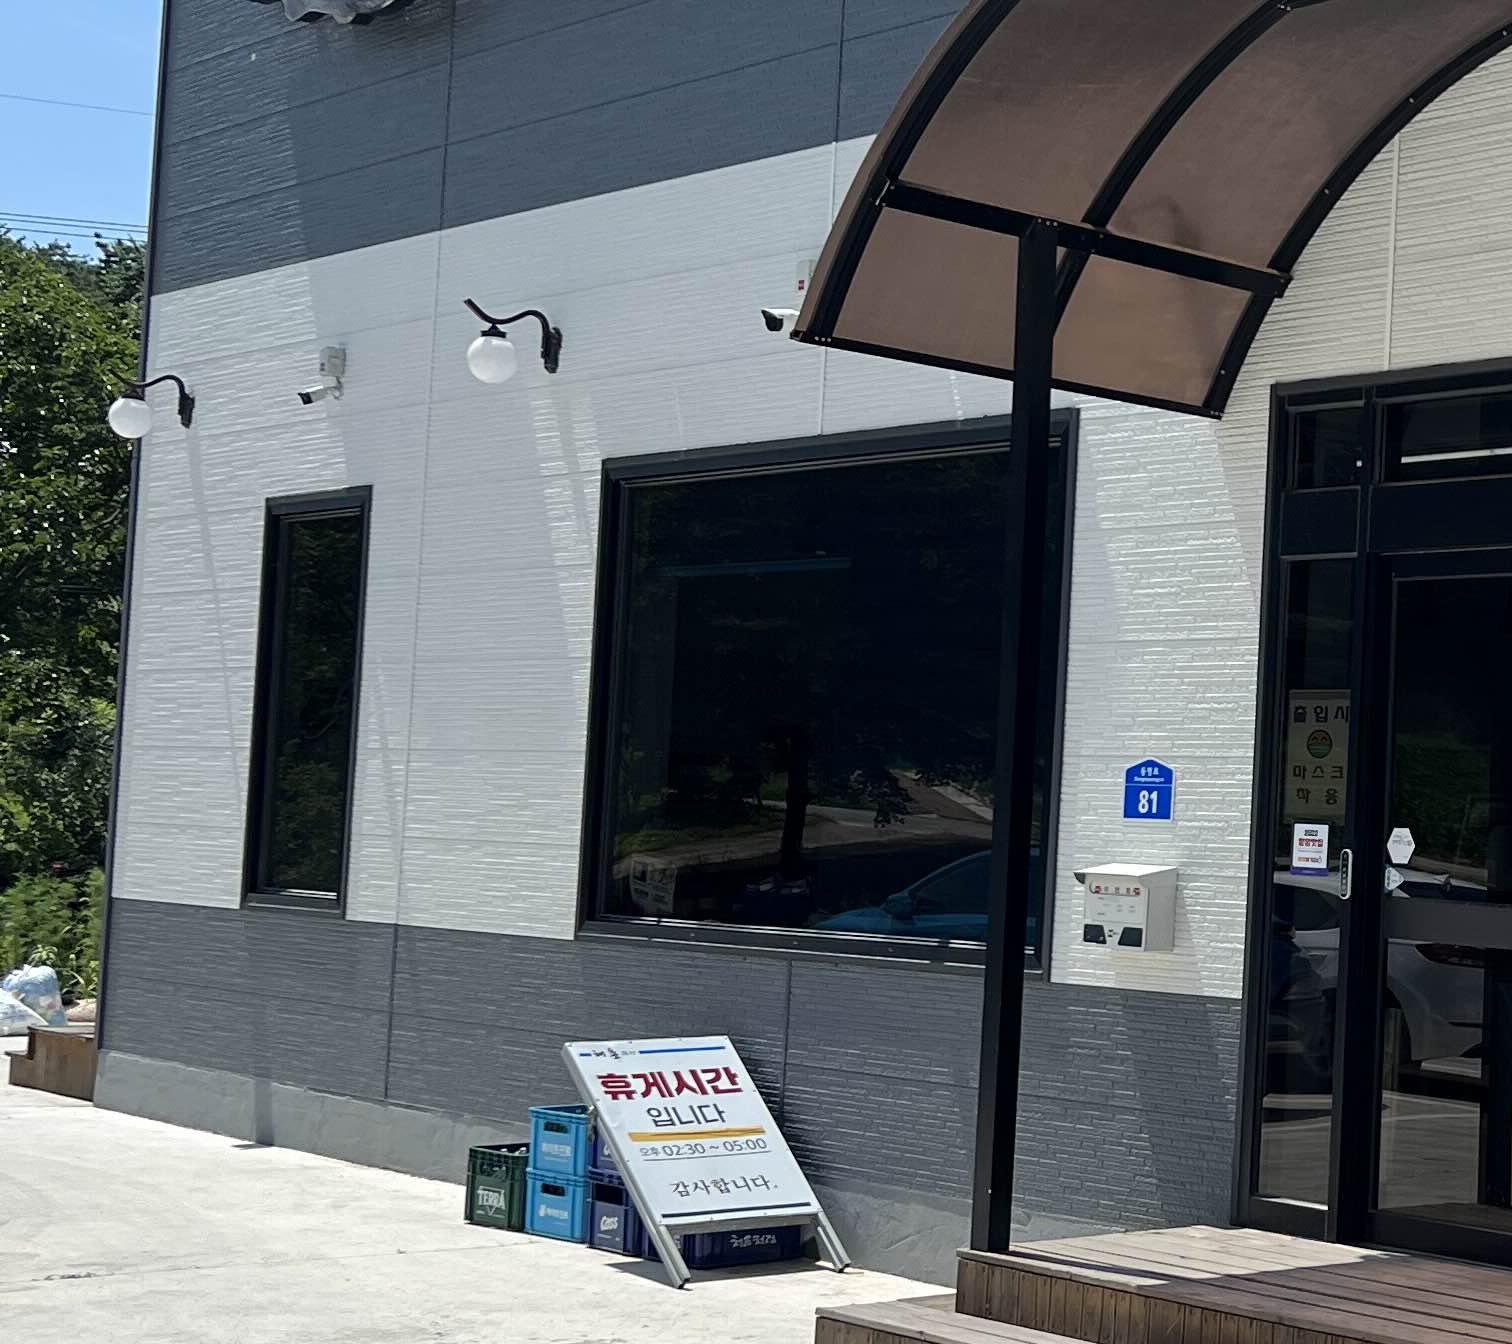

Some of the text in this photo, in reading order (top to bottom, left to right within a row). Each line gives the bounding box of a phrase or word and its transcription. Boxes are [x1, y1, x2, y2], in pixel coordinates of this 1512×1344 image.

[1293, 764, 1344, 780] 마스크
[1138, 790, 1158, 814] 81
[597, 1066, 743, 1101] 휴게시간
[646, 1103, 727, 1128] 입니다
[662, 1143, 705, 1157] 02:30
[724, 1137, 767, 1153] 05:00
[476, 1189, 506, 1209] TERRA
